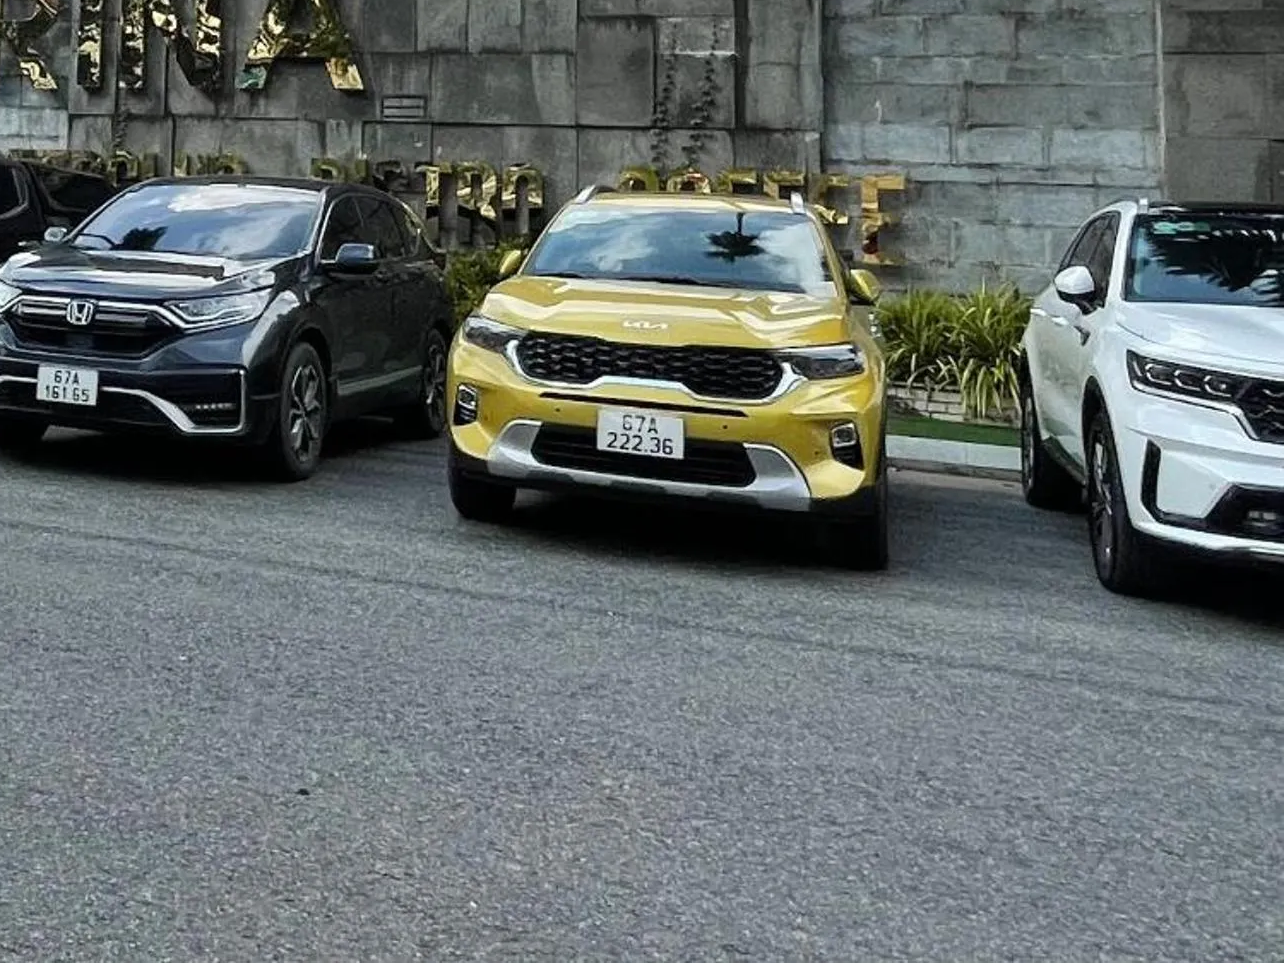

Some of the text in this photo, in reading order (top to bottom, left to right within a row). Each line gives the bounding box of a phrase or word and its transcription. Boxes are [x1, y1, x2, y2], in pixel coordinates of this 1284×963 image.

[54, 370, 80, 385] 67A
[622, 414, 658, 435] 67A
[606, 431, 674, 456] 222.36
